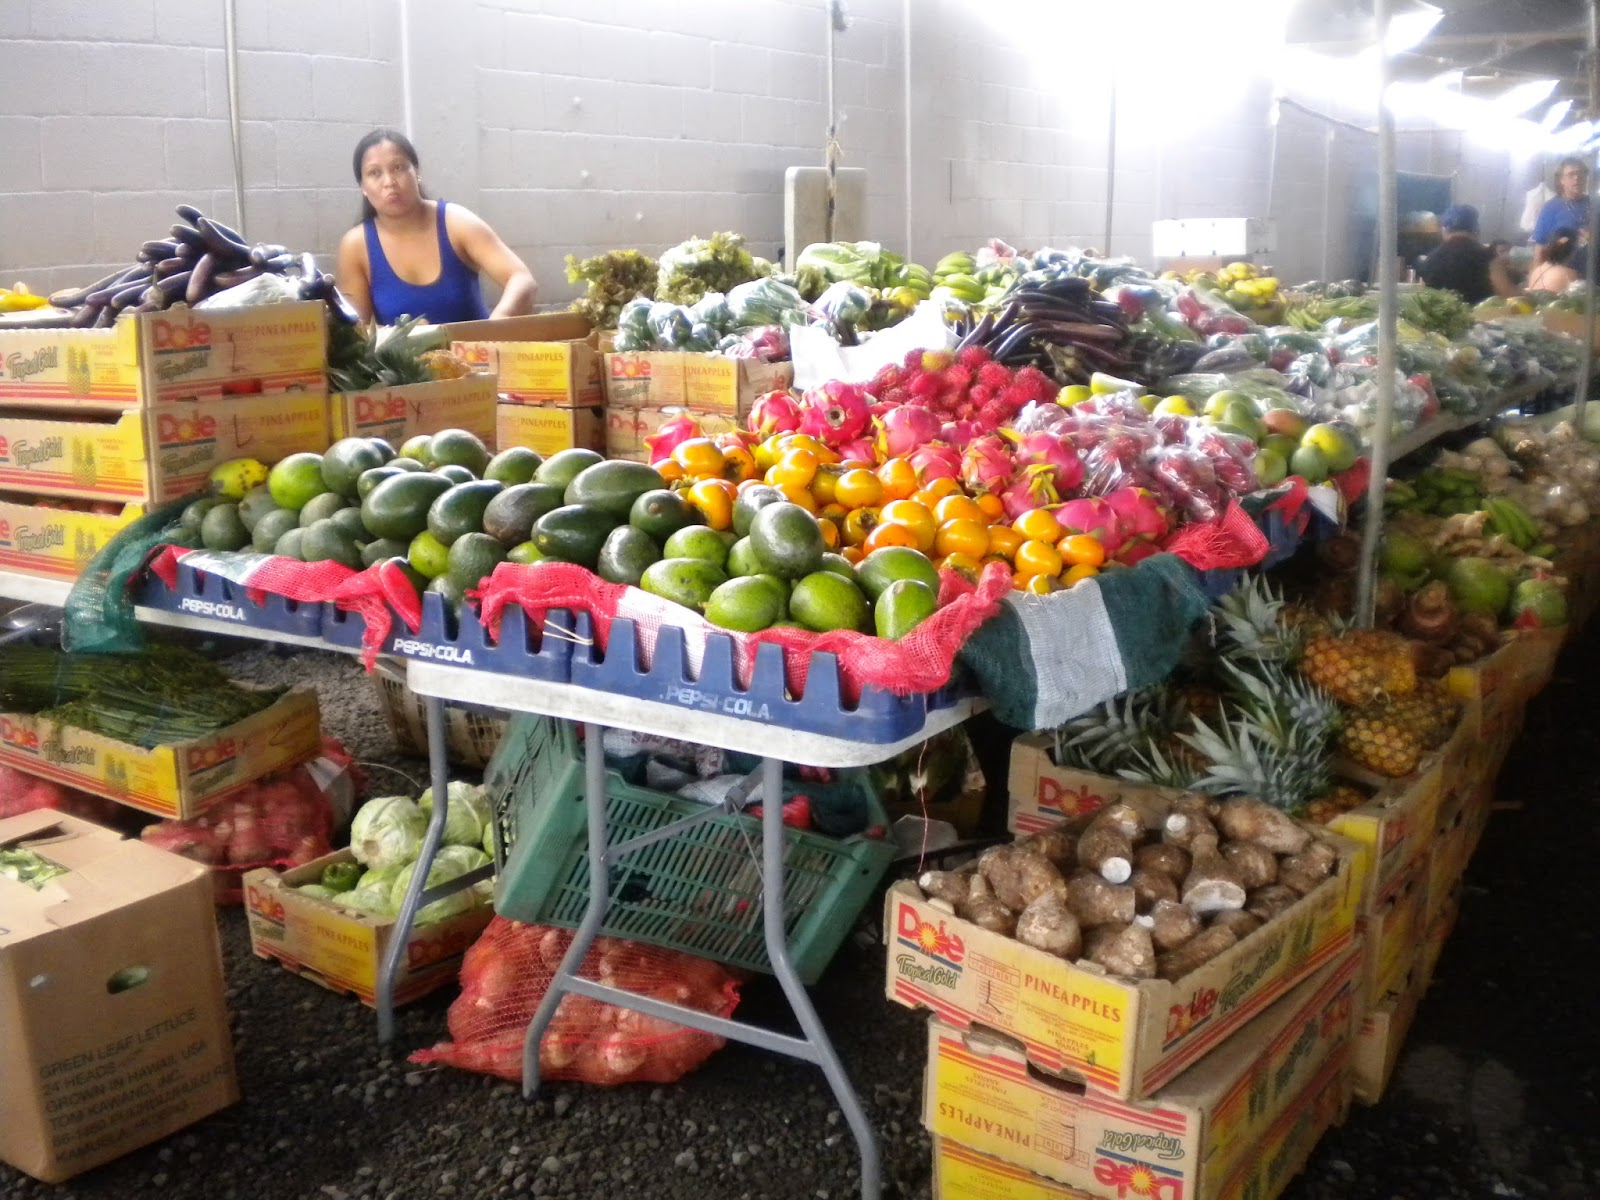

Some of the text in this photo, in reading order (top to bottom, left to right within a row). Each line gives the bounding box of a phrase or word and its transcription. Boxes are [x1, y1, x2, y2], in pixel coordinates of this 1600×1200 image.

[152, 316, 212, 348] Dole
[255, 322, 317, 337] PINEAPPLES
[454, 343, 490, 363] Dole
[517, 352, 564, 362] PINEAPPLES
[611, 356, 651, 377] Dole
[355, 392, 407, 422] Dole
[157, 410, 216, 442] Dole
[520, 417, 566, 429] PINEAPPLES
[0, 716, 38, 748] Dole
[1038, 776, 1105, 816] Dole
[248, 885, 285, 922] Dole
[317, 925, 369, 952] PINEAPPLES
[898, 901, 965, 963] Dole
[896, 953, 958, 990] Tropical Gold
[1024, 973, 1121, 1024] PINEAPPLES
[40, 1007, 196, 1079] GREEN LEAF LETTUCE
[64, 1061, 117, 1088] HEADS
[46, 1085, 104, 1113] GROWN
[939, 1102, 1030, 1147] PINEAPPLES
[1102, 1129, 1132, 1151] Gold
[1132, 1130, 1185, 1160] Tropical
[1094, 1156, 1184, 1200] Dole
